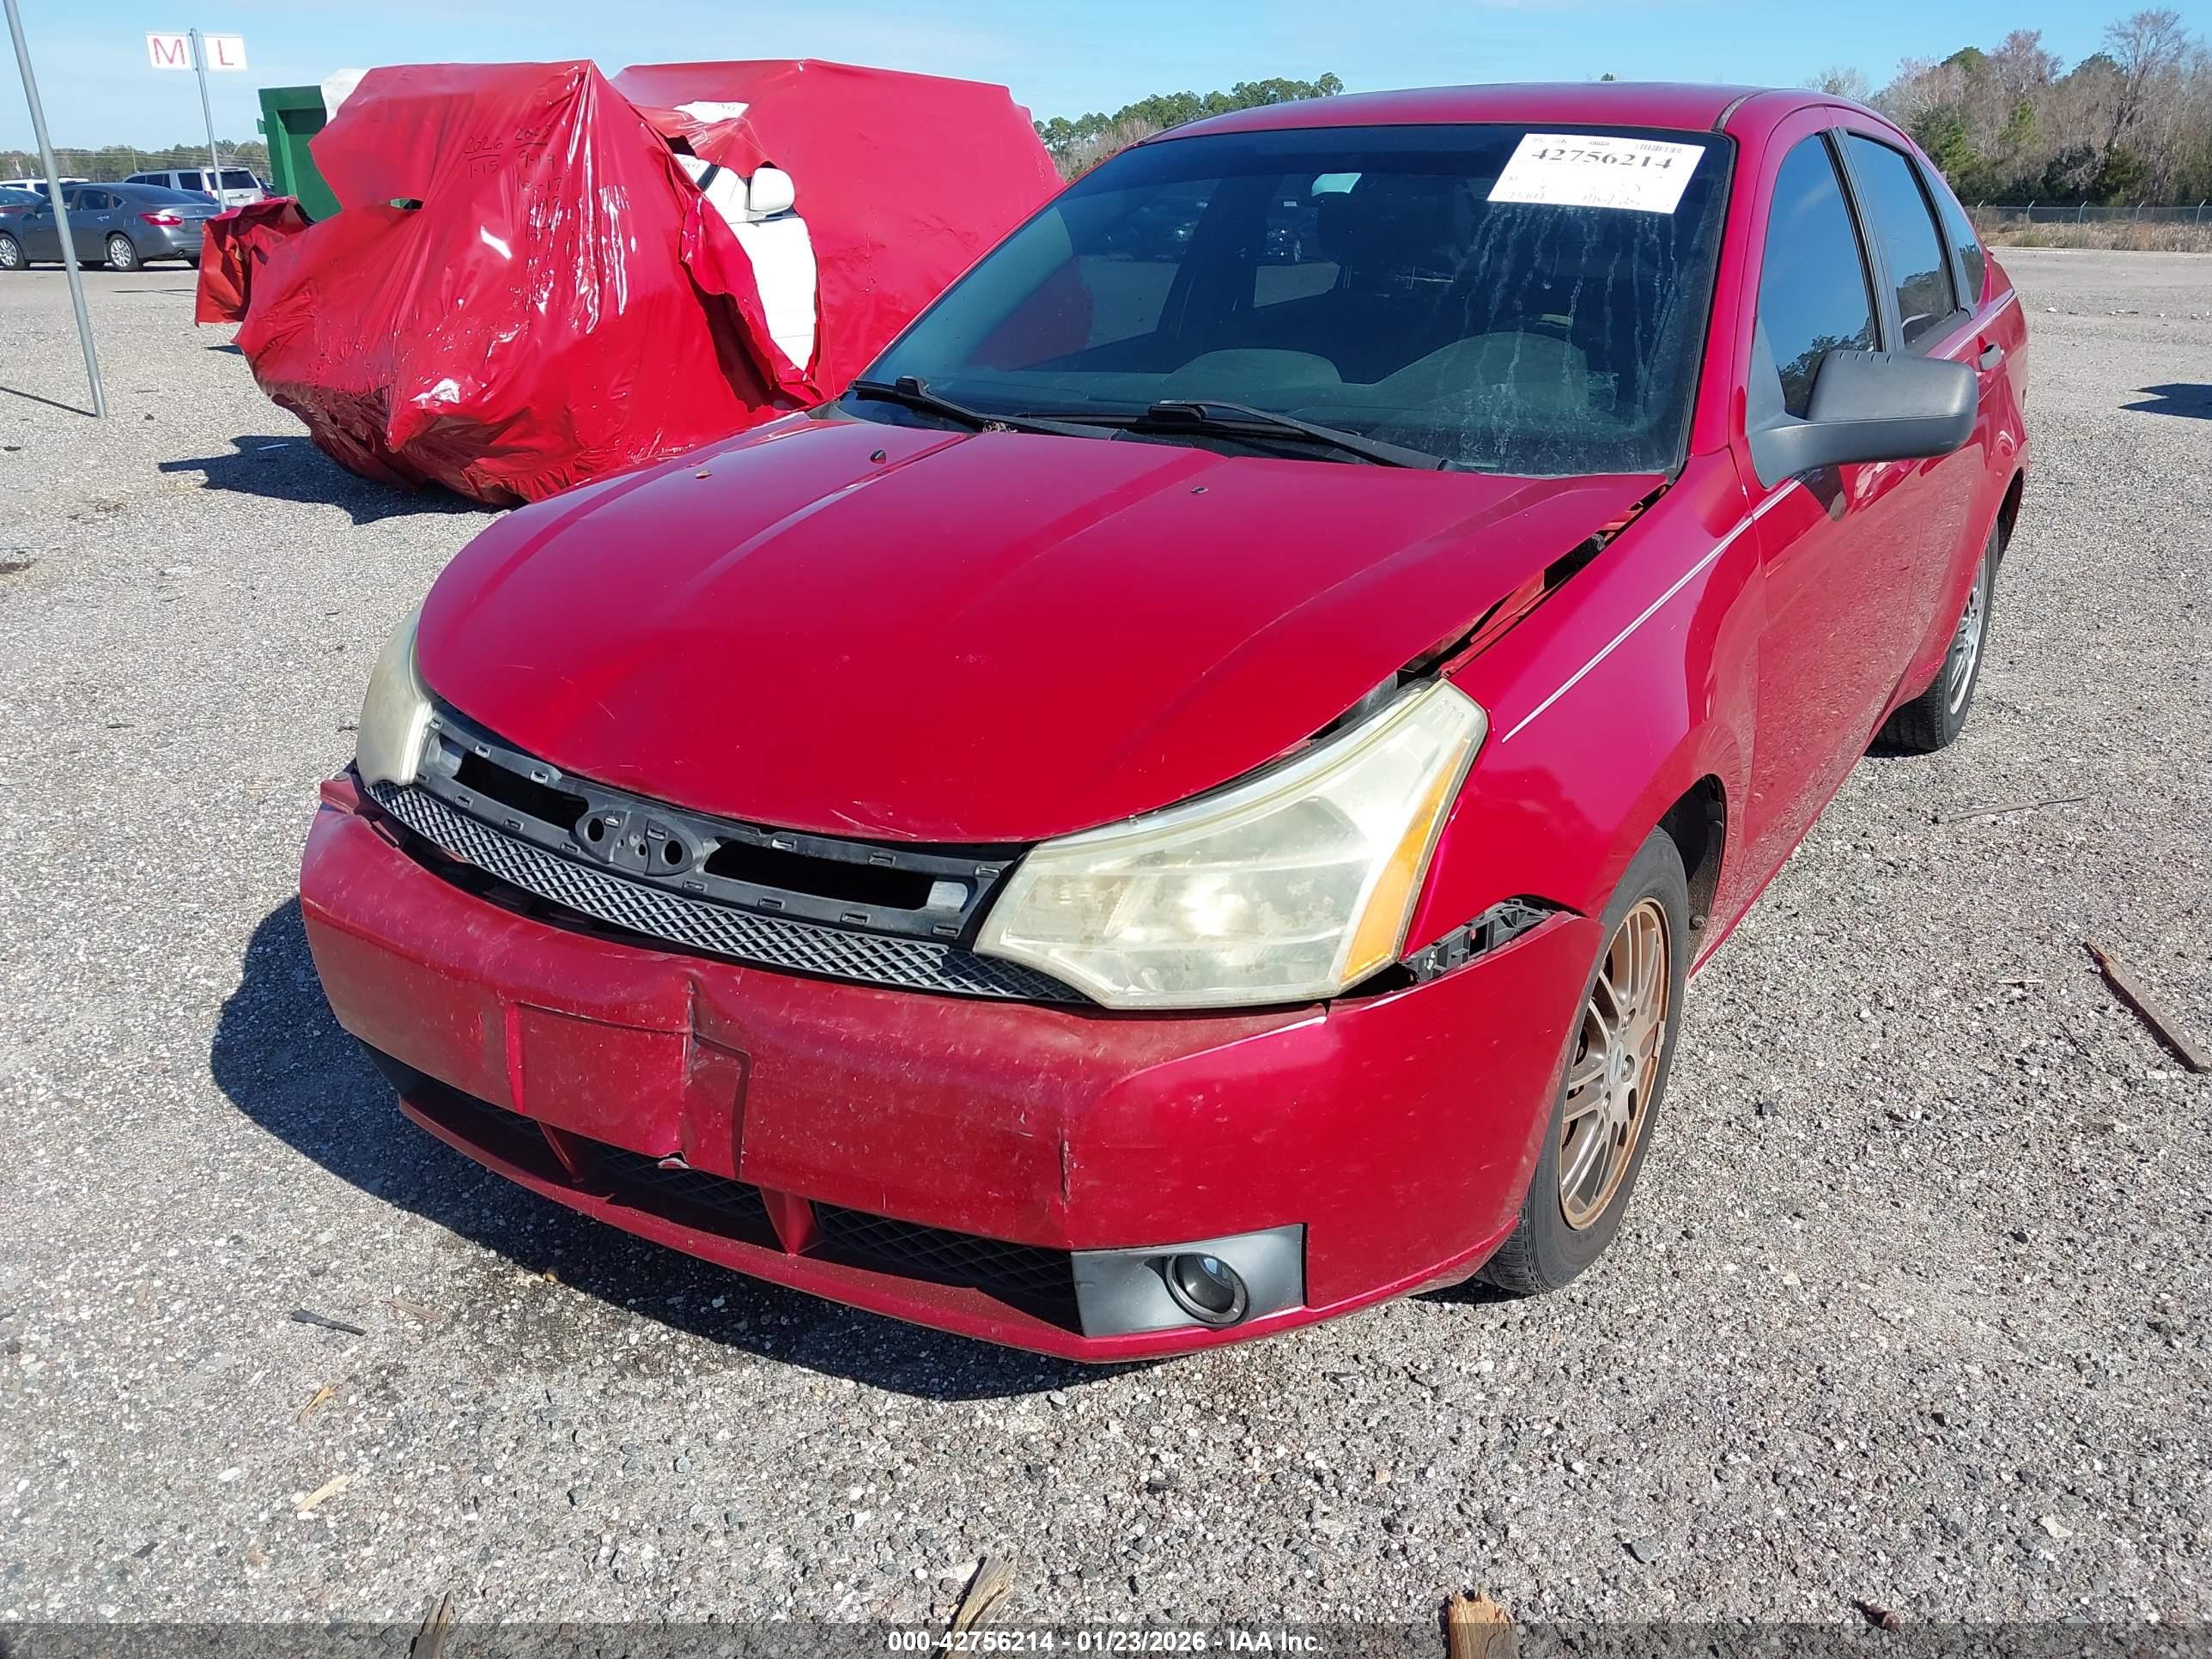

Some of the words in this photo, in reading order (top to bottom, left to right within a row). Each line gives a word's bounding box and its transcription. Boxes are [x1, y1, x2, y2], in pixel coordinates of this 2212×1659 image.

[152, 37, 186, 65] M
[217, 40, 234, 66] L
[463, 136, 503, 154] 2026
[1531, 148, 1674, 169] 42756214
